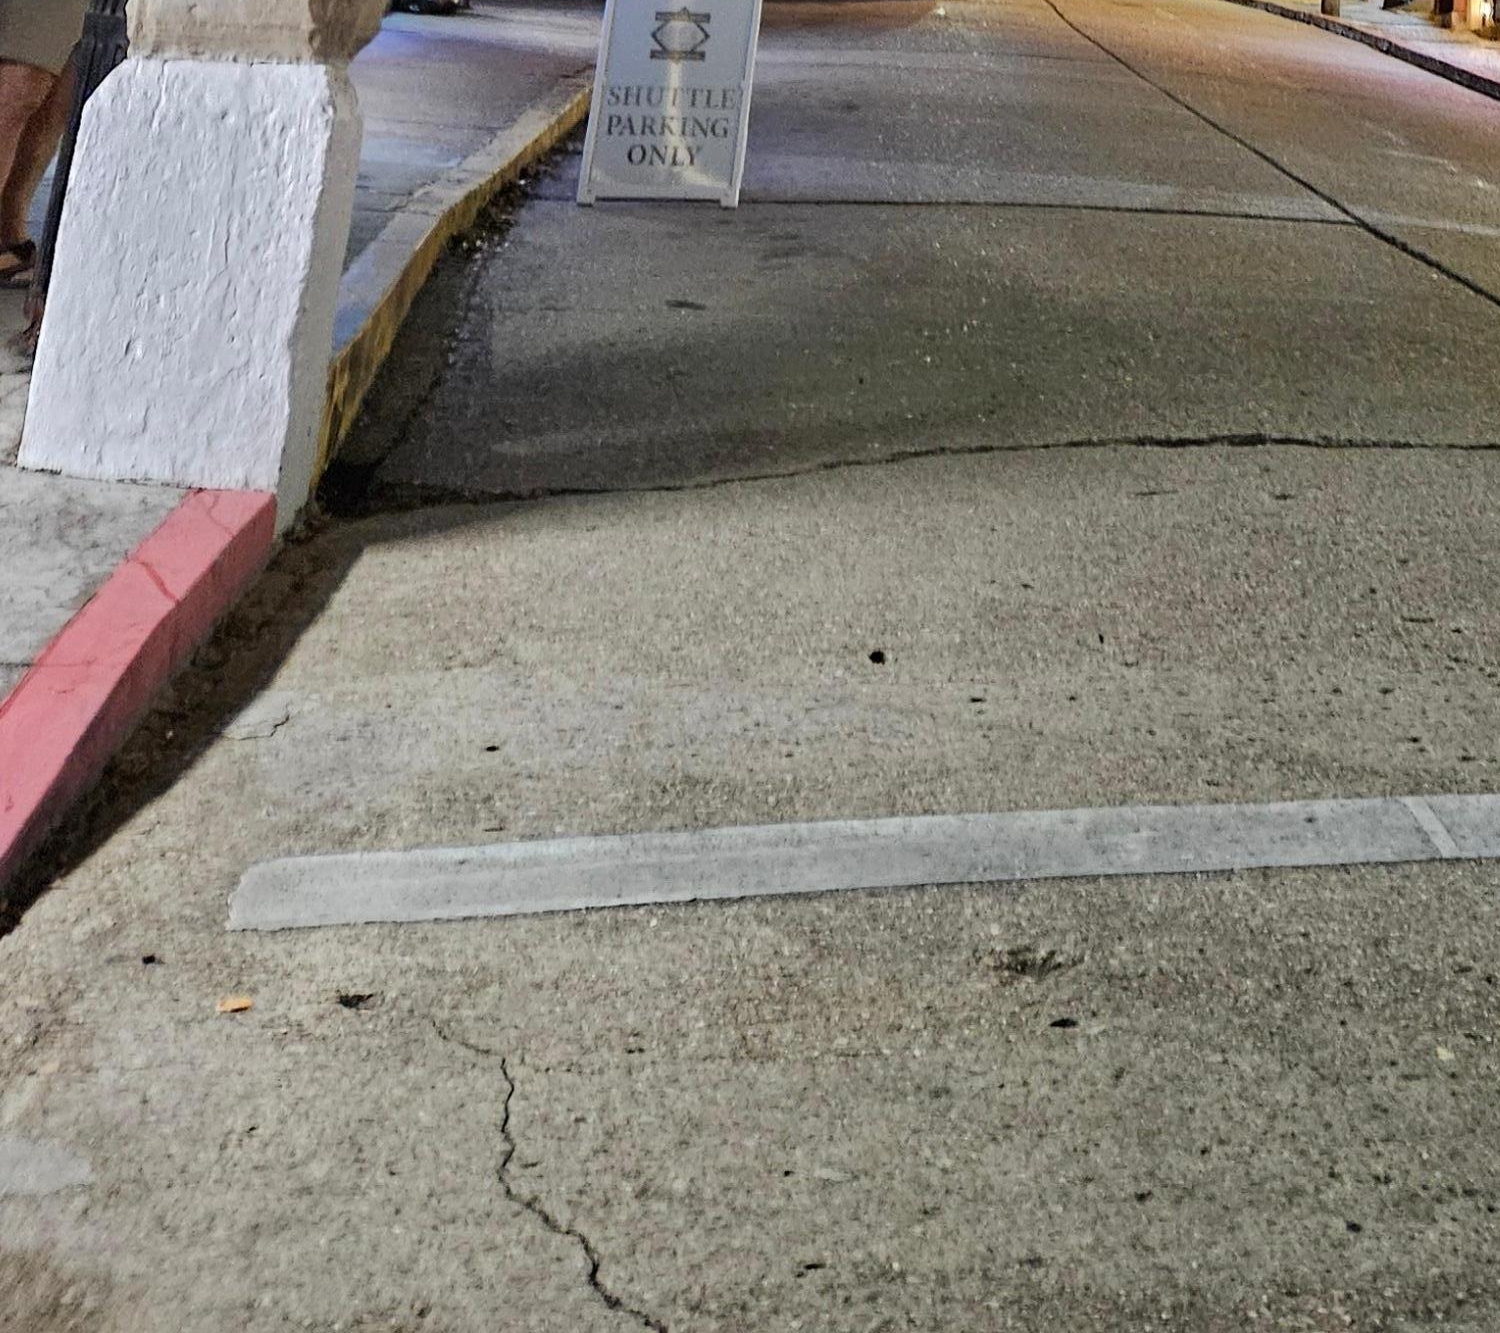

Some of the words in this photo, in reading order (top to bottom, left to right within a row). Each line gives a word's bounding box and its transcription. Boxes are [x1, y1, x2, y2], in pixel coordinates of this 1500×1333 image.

[606, 84, 736, 110] SHUTTLE
[606, 116, 730, 139] PARKING
[627, 144, 704, 166] ONLY
